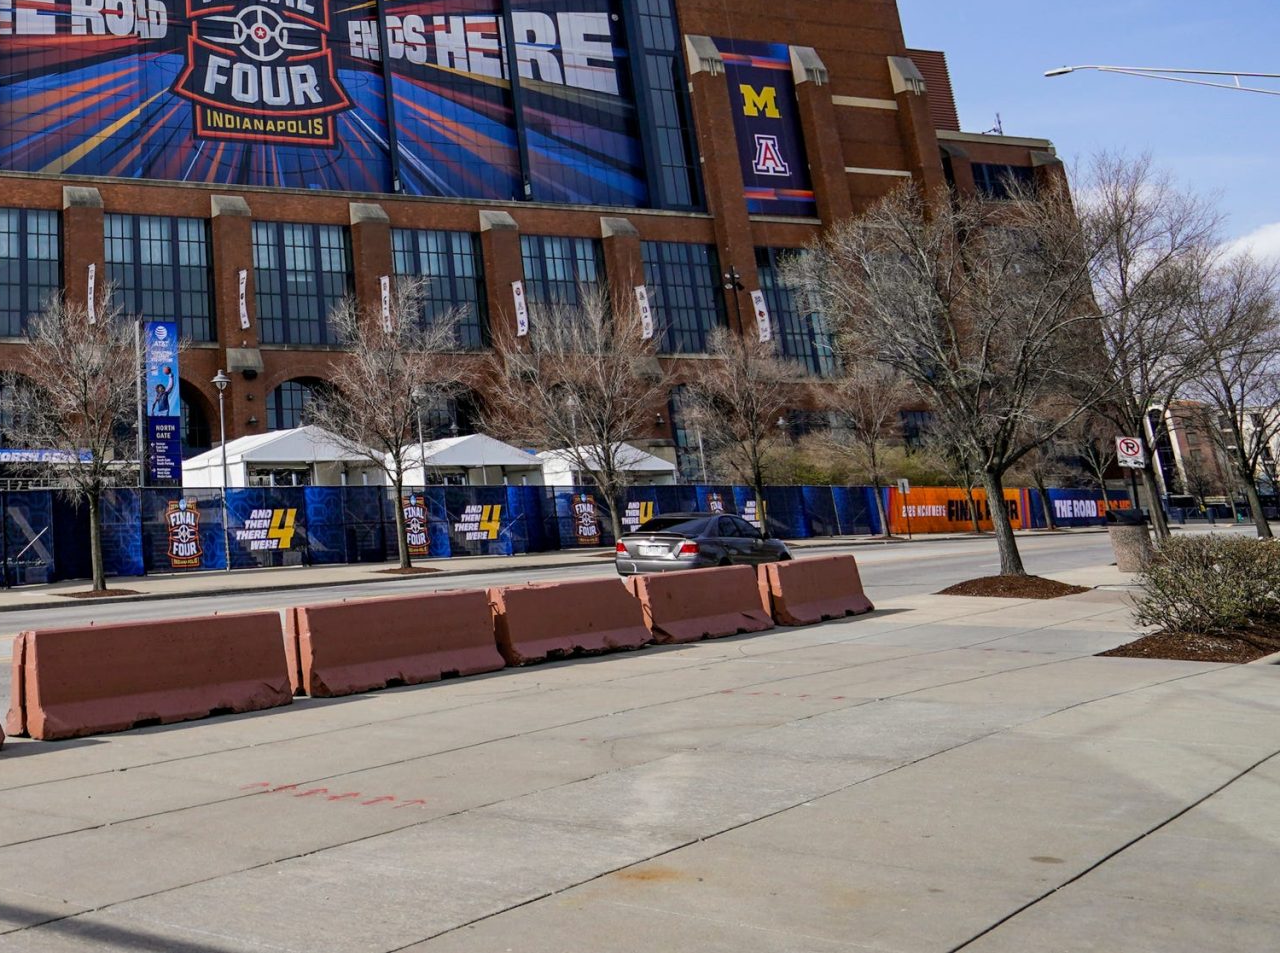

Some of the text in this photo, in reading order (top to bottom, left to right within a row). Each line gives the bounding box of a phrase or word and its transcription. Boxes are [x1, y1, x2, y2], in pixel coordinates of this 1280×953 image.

[348, 11, 619, 95] ENDS HERE
[204, 54, 322, 106] FOUR
[739, 84, 781, 119] M
[207, 110, 323, 135] INDIANAPOLIS
[752, 134, 789, 177] A
[465, 505, 482, 514] AND
[575, 503, 594, 514] FINAL
[628, 501, 639, 509] AND
[947, 499, 983, 521] FINL
[1054, 500, 1073, 517] THE
[1074, 500, 1097, 517] ROAD
[170, 511, 195, 526] FINAL
[250, 509, 272, 519] AND
[404, 506, 424, 519] FINAL
[461, 514, 481, 522] THEN
[245, 519, 270, 529] THEN
[268, 508, 297, 548] 4
[455, 523, 479, 531] THERE
[479, 504, 501, 540] 4
[236, 529, 268, 540] THERE
[466, 531, 488, 540] WERE
[578, 525, 597, 536] FOUR
[250, 539, 278, 550] WERE
[407, 533, 426, 545] FOUR
[173, 541, 197, 556] FOUR
